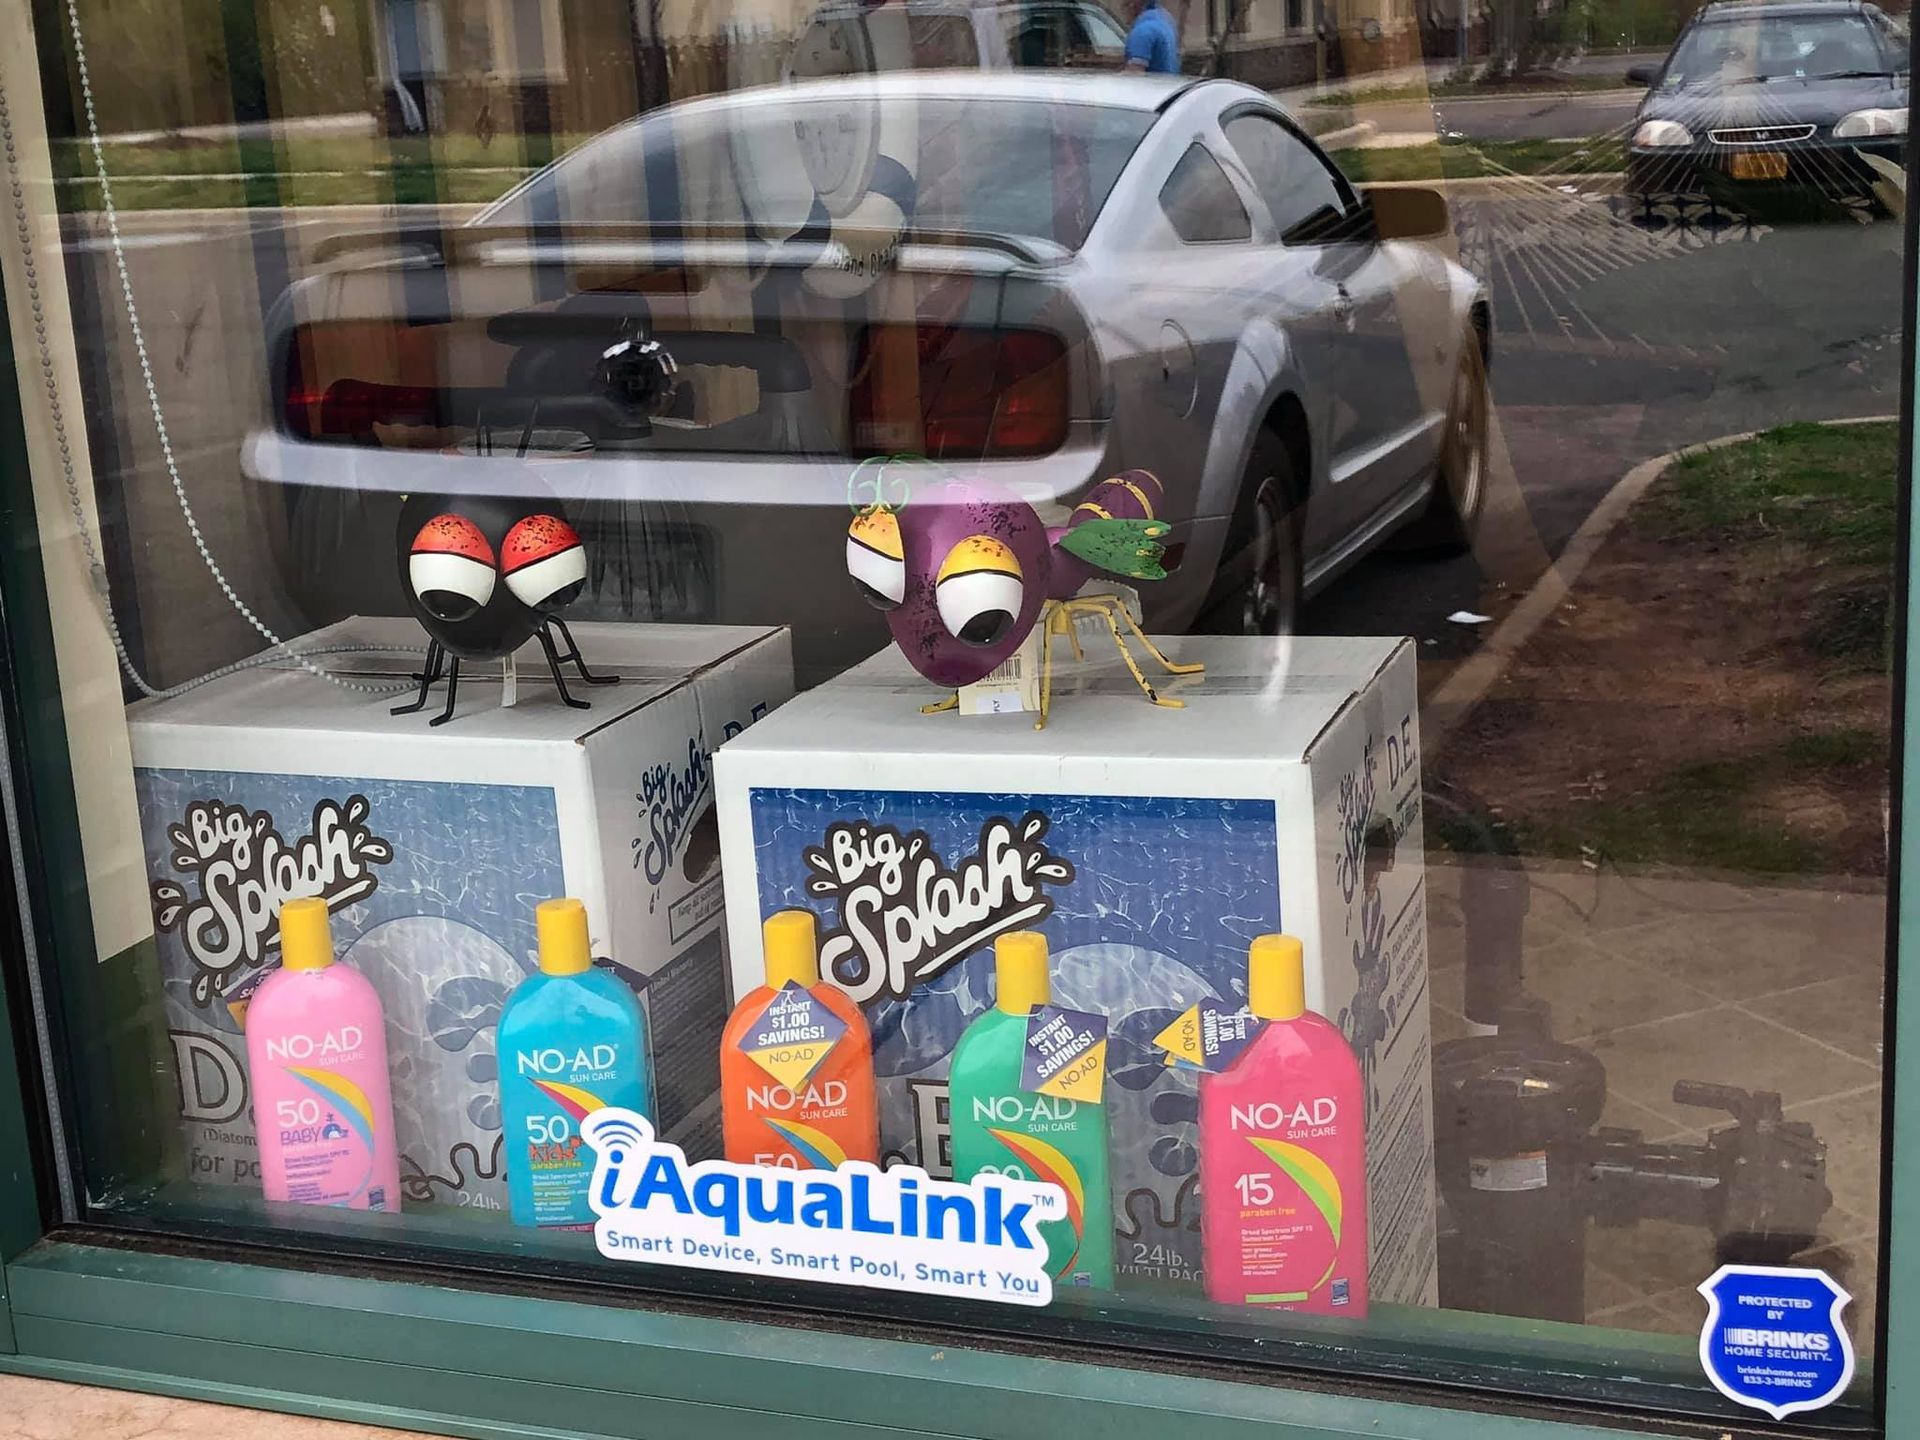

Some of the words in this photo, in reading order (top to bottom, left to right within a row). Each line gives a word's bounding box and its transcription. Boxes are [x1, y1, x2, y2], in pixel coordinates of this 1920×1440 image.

[642, 764, 666, 807] Big
[644, 737, 705, 886] Splash
[191, 806, 252, 871] Big
[832, 827, 905, 896] Big
[186, 806, 360, 969] Splash
[820, 824, 1034, 1003] Splash
[769, 1001, 811, 1016] INSTANT
[772, 1012, 809, 1029] $1.00
[266, 1026, 362, 1060] NO-AD
[758, 1025, 825, 1046] SAVINGS!
[1028, 1013, 1067, 1047] INSTANT
[1038, 1025, 1075, 1056] $1.00
[1182, 1019, 1196, 1052] NO-AD
[1203, 1009, 1220, 1056] SAVINGS!
[341, 1052, 365, 1063] CARE
[517, 1044, 616, 1074] NO-AD
[769, 1048, 814, 1064] NO-AD
[1036, 1029, 1096, 1079] SAVINGS!
[570, 1074, 589, 1083] SUN
[592, 1071, 617, 1081] CARE
[1058, 1056, 1098, 1090] NO-AD
[746, 1080, 848, 1111] NO-AD
[972, 1096, 1077, 1122] NO-AD
[276, 1098, 320, 1128] 50
[800, 1110, 820, 1120] SUN
[822, 1107, 848, 1118] CARE
[1028, 1123, 1048, 1133] SUN
[1051, 1121, 1077, 1131] CARE
[1231, 1098, 1337, 1130] NO-AD
[280, 1126, 322, 1146] BABY
[526, 1115, 569, 1144] 50
[1287, 1129, 1308, 1139] SUN
[1311, 1126, 1337, 1137] CARE
[600, 1150, 1034, 1250] iAquaLink
[1234, 1173, 1274, 1206] 15
[1240, 1208, 1276, 1219] paraben
[1278, 1207, 1296, 1216] free
[607, 1230, 673, 1253] Smart
[683, 1238, 761, 1265] Device,
[771, 1247, 840, 1272] Smart
[850, 1256, 905, 1281] Pool,
[915, 1263, 987, 1287] Smart
[996, 1270, 1039, 1293] You
[1133, 1243, 1189, 1267] 24lb.
[1738, 1295, 1812, 1309] PROTECTED
[1767, 1310, 1784, 1320] BY
[1724, 1346, 1763, 1358] HOME
[1740, 1328, 1830, 1351] BRINKS
[1737, 1364, 1818, 1379] brinkshome.com
